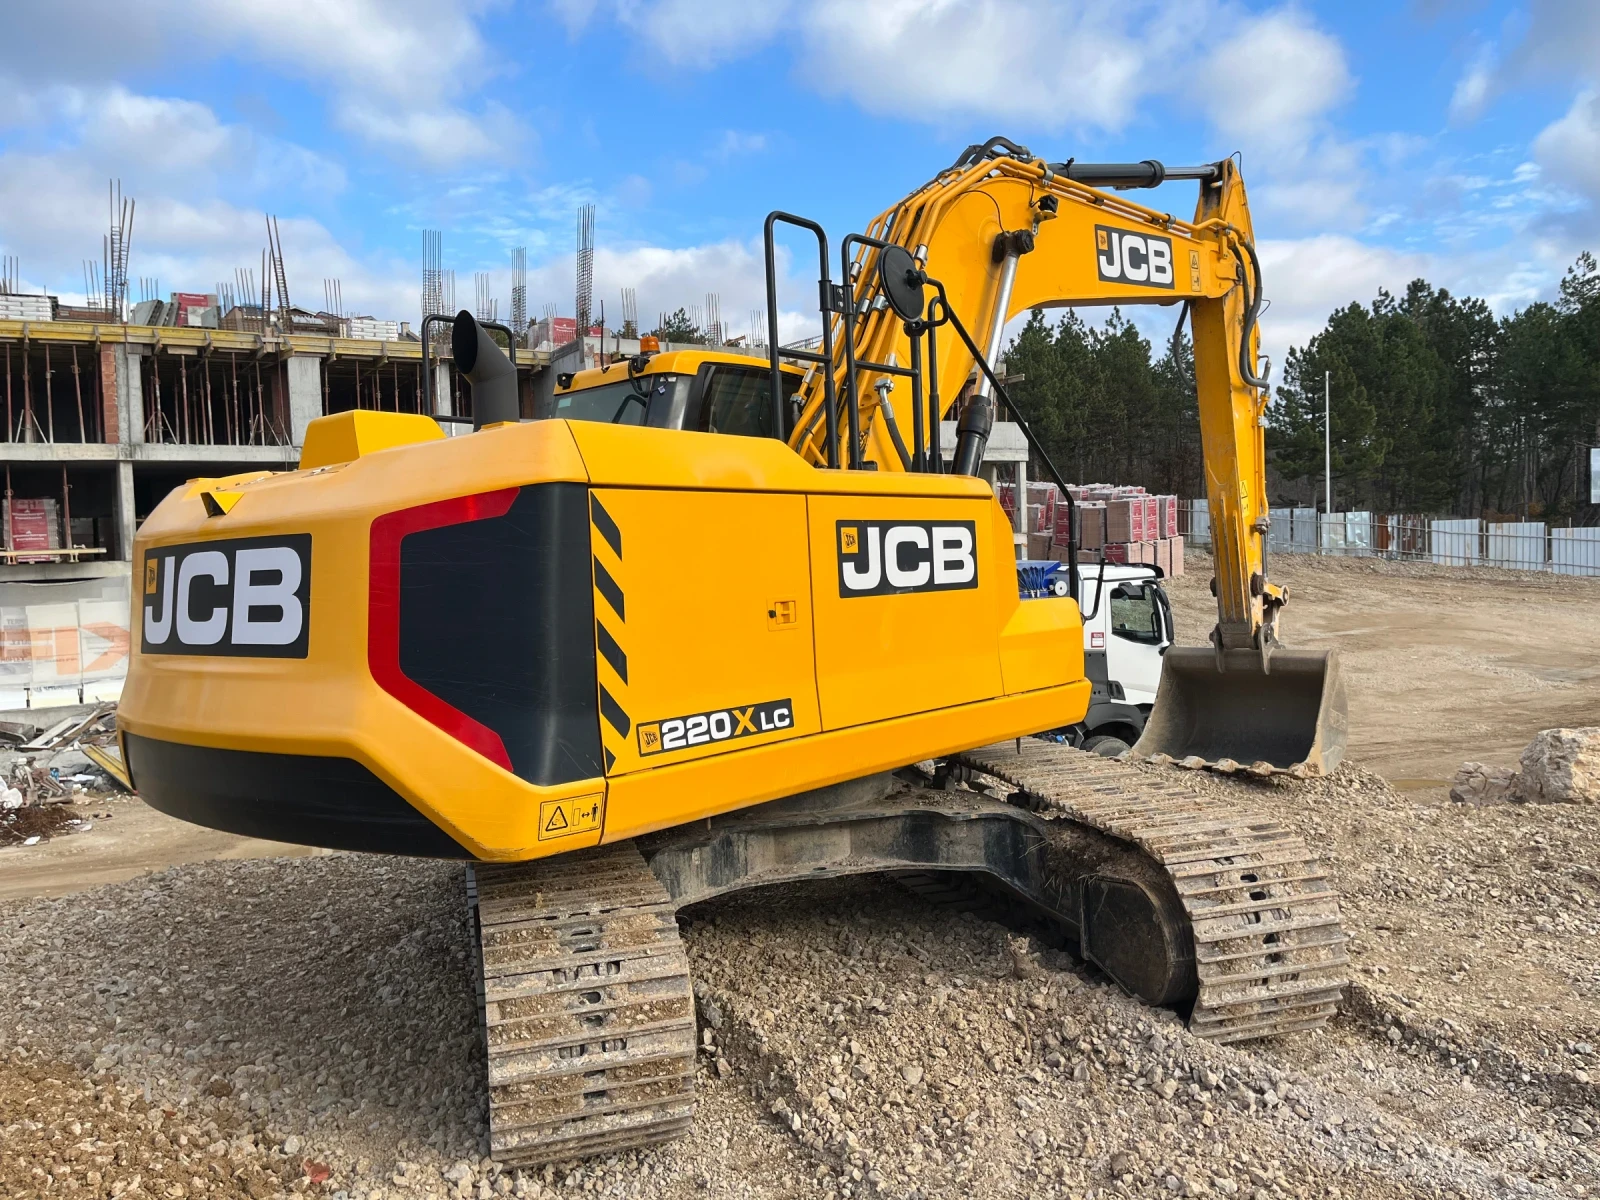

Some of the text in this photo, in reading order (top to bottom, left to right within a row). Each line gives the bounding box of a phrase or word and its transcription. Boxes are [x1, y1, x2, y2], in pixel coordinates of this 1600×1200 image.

[1099, 232, 1172, 284] JCB
[842, 526, 975, 590] JCB
[144, 546, 303, 645] JCB
[760, 708, 790, 730] LC
